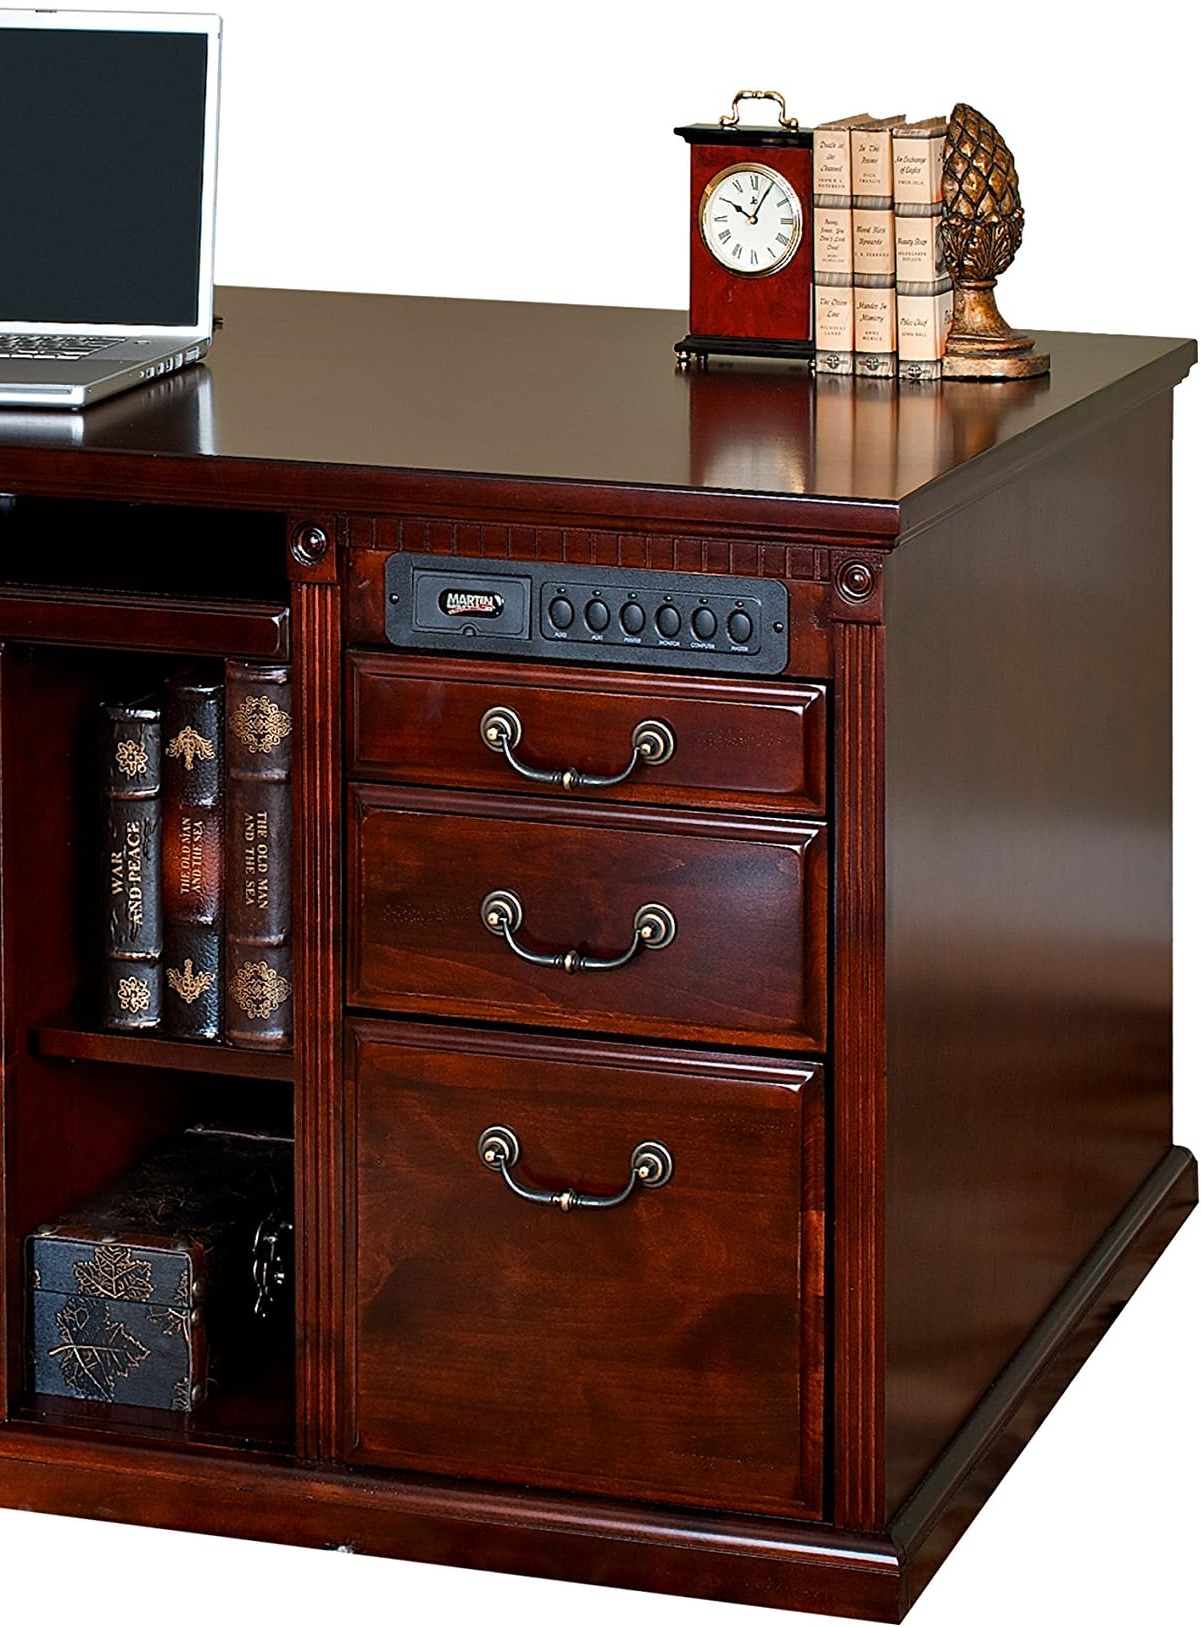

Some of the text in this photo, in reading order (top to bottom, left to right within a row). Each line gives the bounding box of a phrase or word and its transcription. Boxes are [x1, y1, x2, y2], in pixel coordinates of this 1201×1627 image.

[446, 593, 493, 608] MARTIN
[111, 851, 124, 895] WAR
[126, 820, 143, 926] AND PEACE
[180, 817, 191, 894] THE OLD MAN
[192, 820, 203, 892] AND THE SEA
[245, 812, 256, 906] AND THE SEA
[257, 811, 269, 909] THE OLD MAN
